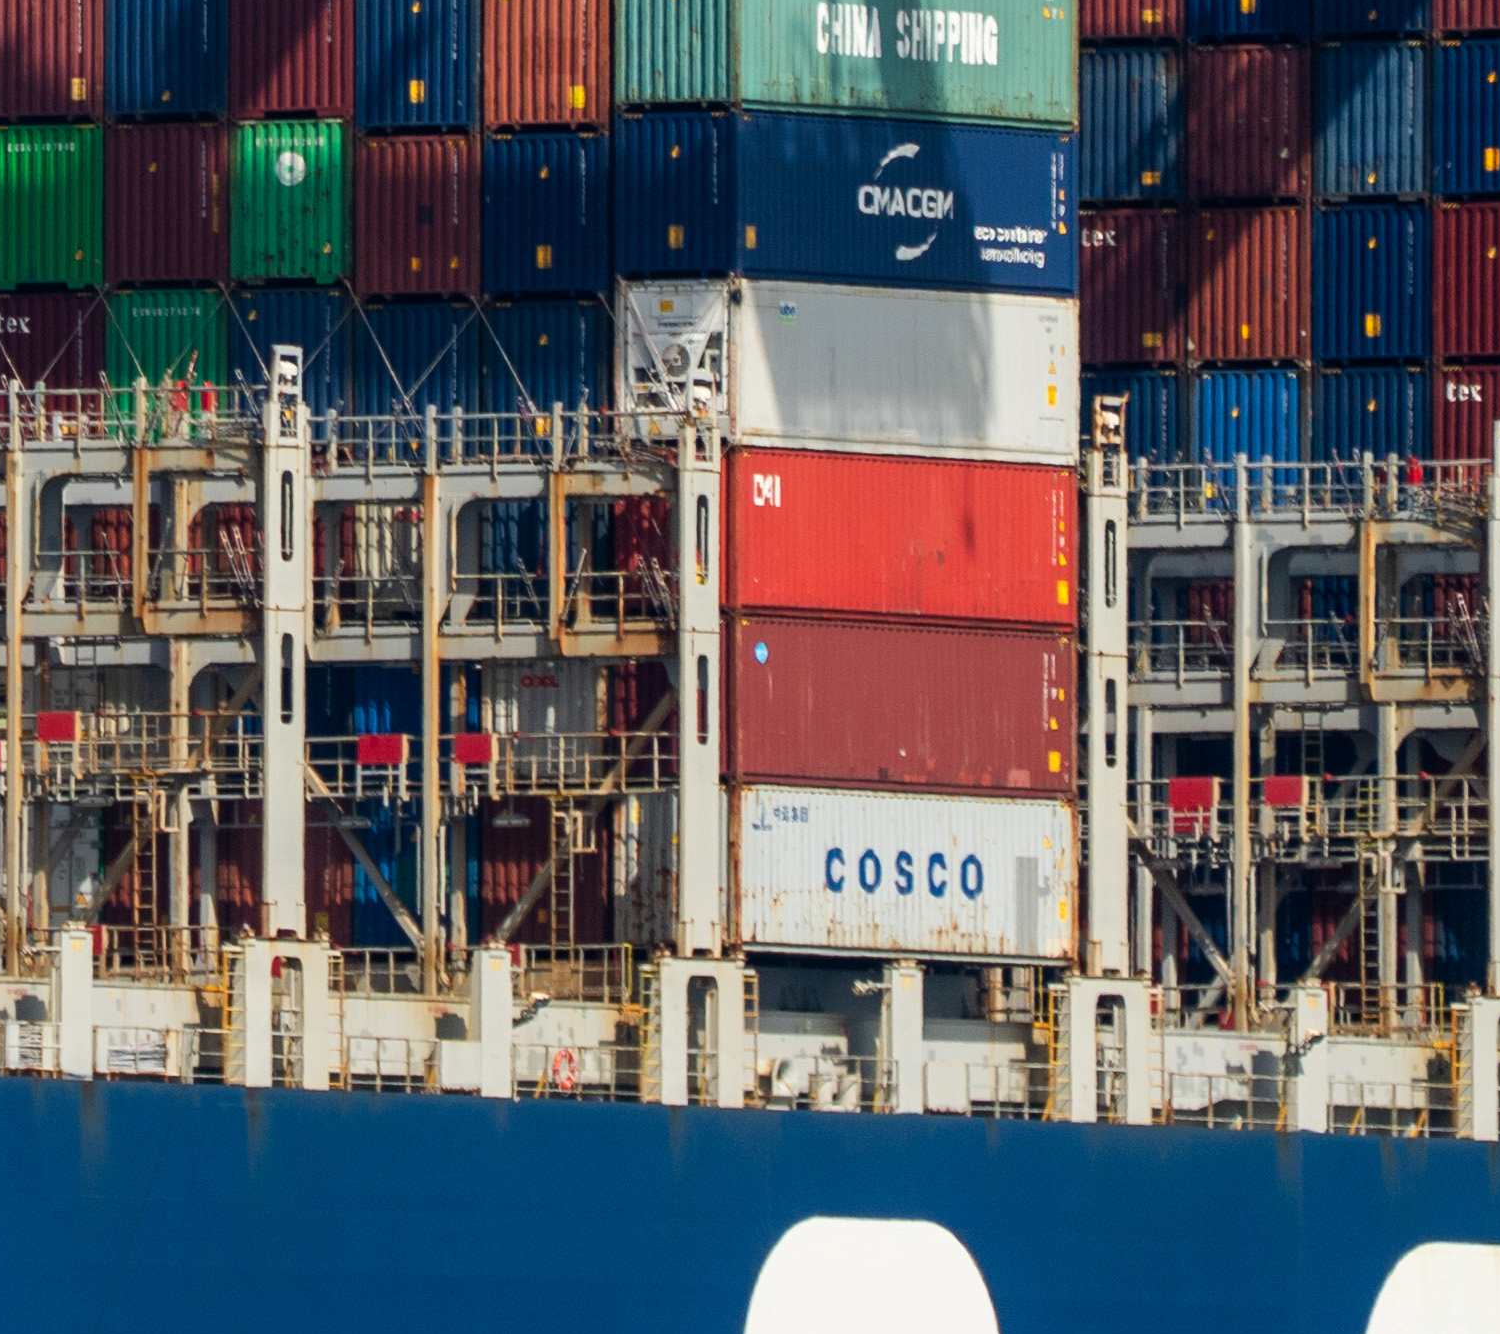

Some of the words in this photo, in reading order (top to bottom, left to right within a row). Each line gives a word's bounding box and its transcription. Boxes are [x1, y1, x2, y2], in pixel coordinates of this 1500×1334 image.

[816, 1, 882, 59] CHINA
[895, 9, 999, 66] SHIPPING
[857, 185, 906, 217] CMA
[907, 188, 954, 220] CGM
[1081, 228, 1117, 247] tex
[1446, 380, 1482, 402] tex
[824, 846, 986, 900] COSCO
